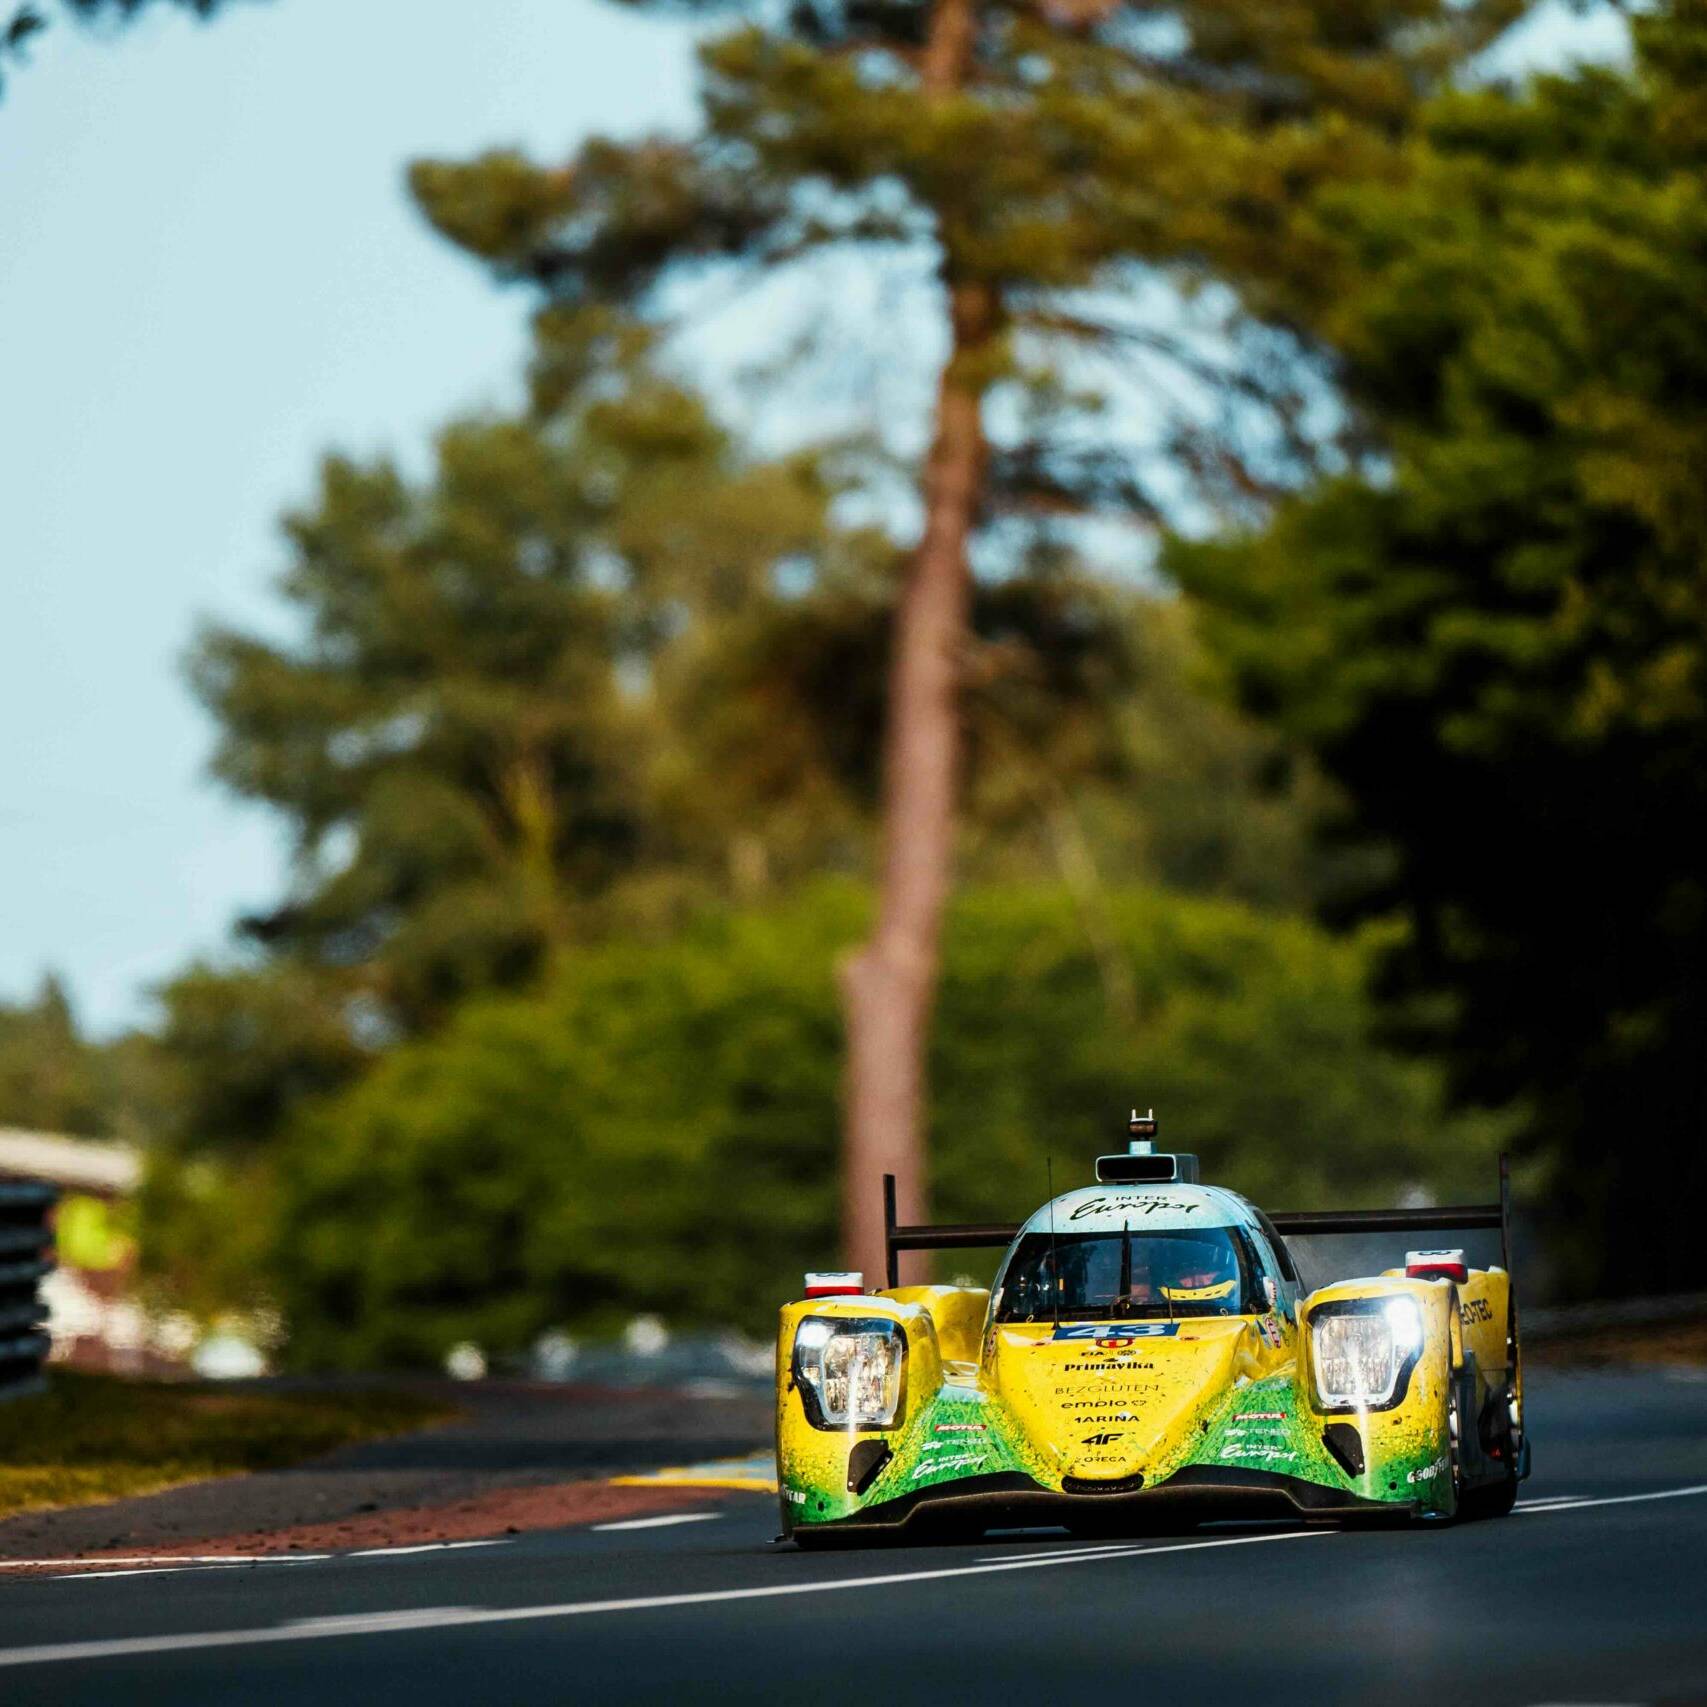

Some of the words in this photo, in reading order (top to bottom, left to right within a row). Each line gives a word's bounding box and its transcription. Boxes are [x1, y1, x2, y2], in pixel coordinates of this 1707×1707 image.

[1066, 1324, 1166, 1338] 43
[1063, 1361, 1154, 1372] Primavika
[1055, 1384, 1160, 1395] BEZGLUTEN
[1081, 1432, 1125, 1445] 4F
